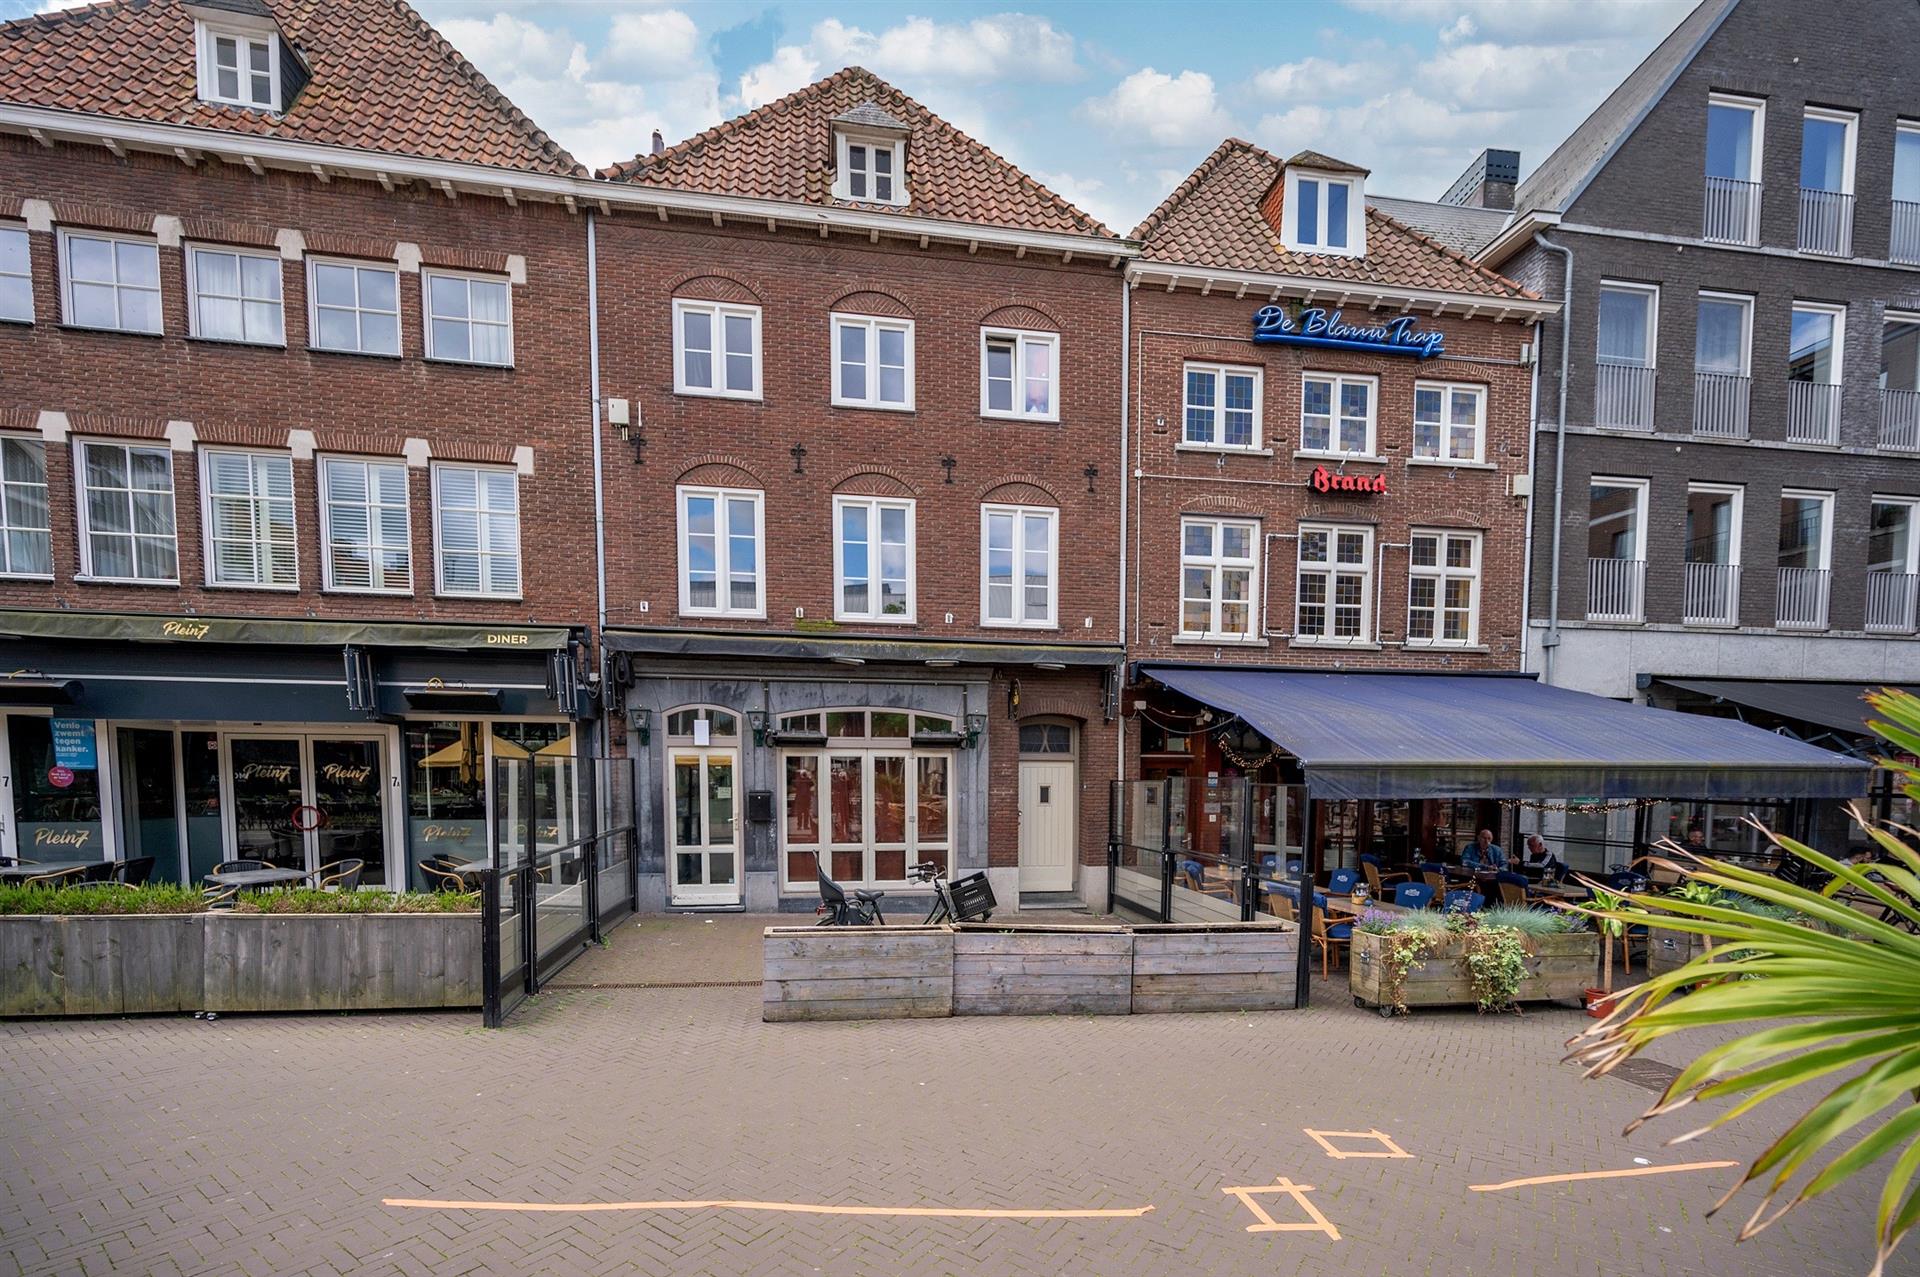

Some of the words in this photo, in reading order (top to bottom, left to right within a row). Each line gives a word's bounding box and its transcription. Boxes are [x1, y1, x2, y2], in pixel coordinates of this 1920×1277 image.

[1257, 305, 1295, 331] De
[1302, 308, 1387, 339] Blauw
[1391, 316, 1444, 357] Trap
[1312, 464, 1387, 493] Brand
[163, 621, 210, 639] Plein7
[487, 634, 528, 644] DINER
[54, 721, 80, 729] Venlo
[55, 737, 81, 745] tegen
[243, 763, 292, 781] Plein7
[324, 763, 371, 782] Plein7
[35, 828, 91, 848] Plein7
